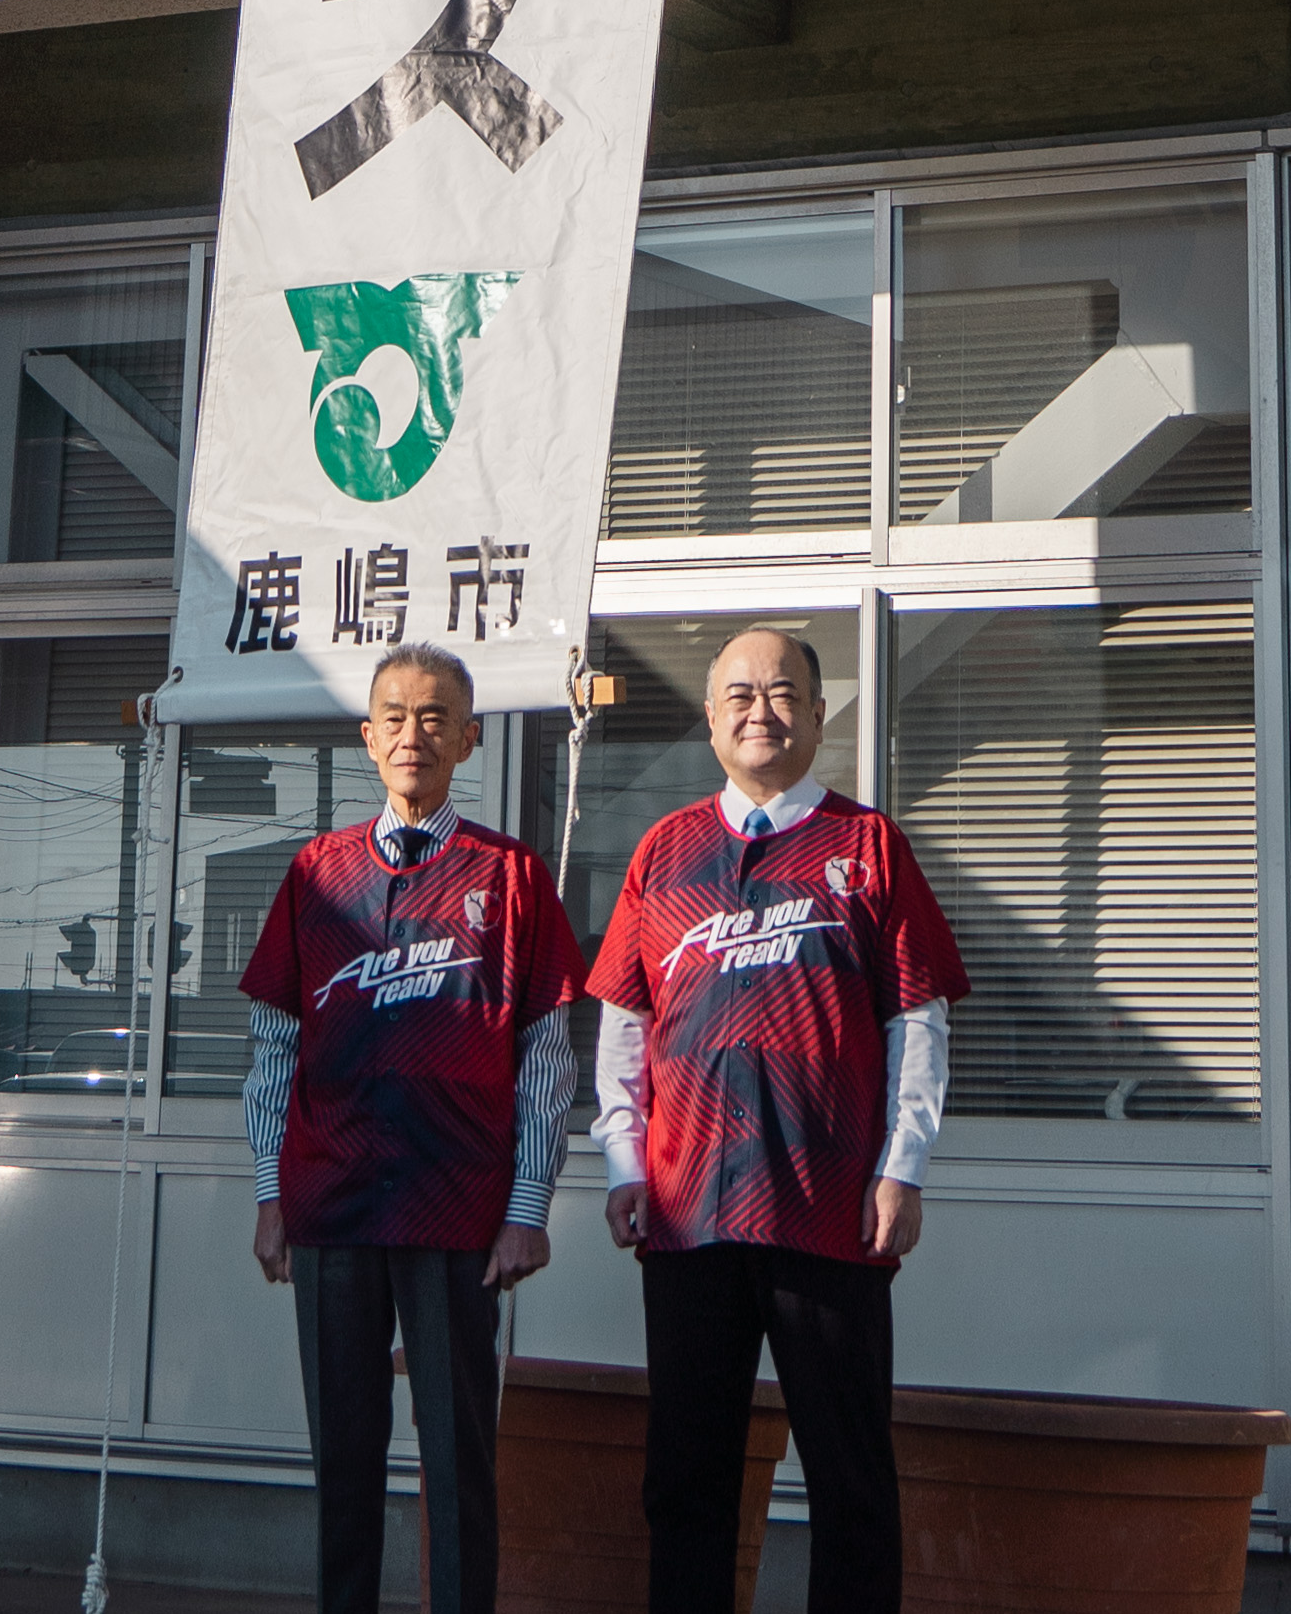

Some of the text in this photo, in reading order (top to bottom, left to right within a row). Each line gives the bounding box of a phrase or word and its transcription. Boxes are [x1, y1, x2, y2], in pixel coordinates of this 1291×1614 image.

[224, 535, 530, 655] 鹿嶋市
[314, 936, 456, 1010] Are you
[660, 897, 814, 982] Are you
[720, 932, 804, 974] ready
[372, 969, 447, 1010] ready
